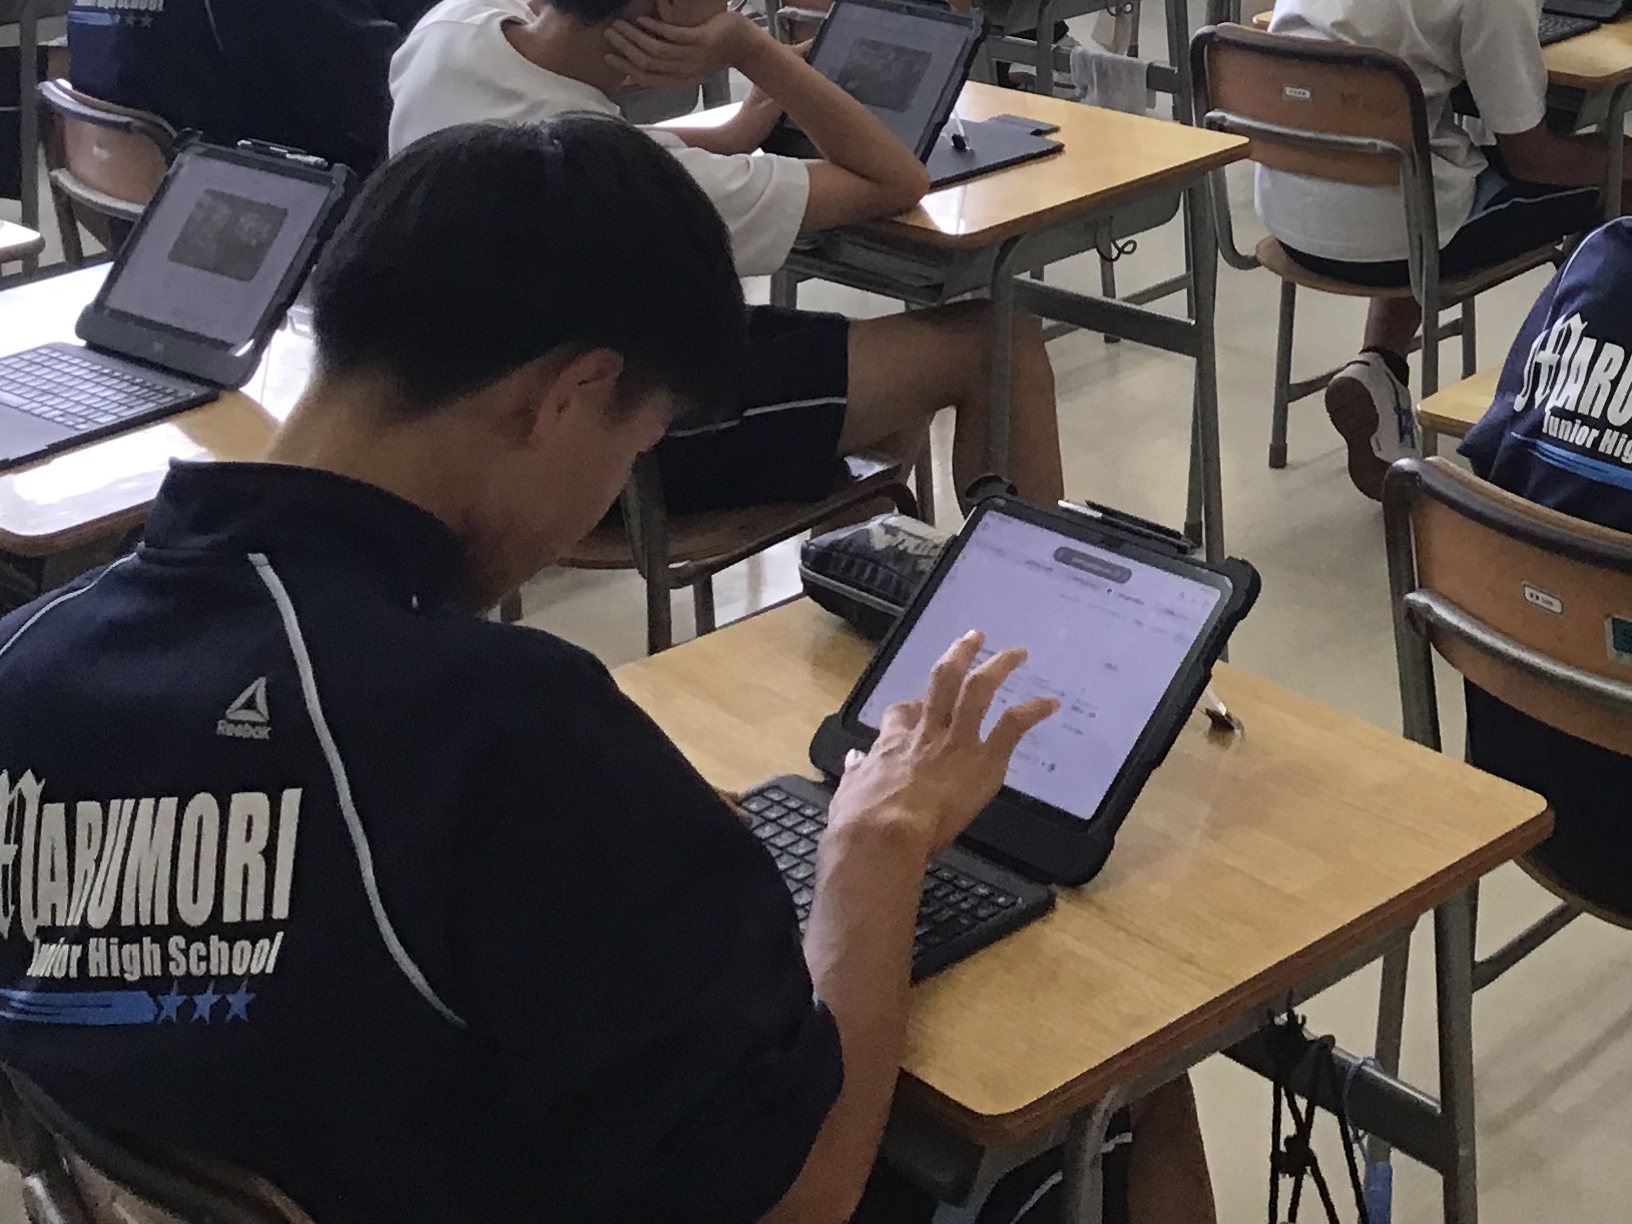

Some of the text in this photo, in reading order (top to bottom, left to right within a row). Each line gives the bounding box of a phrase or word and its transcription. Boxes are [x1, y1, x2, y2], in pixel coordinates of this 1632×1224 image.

[1542, 412, 1600, 450] Junior
[88, 936, 161, 981] High
[168, 932, 284, 977] School
